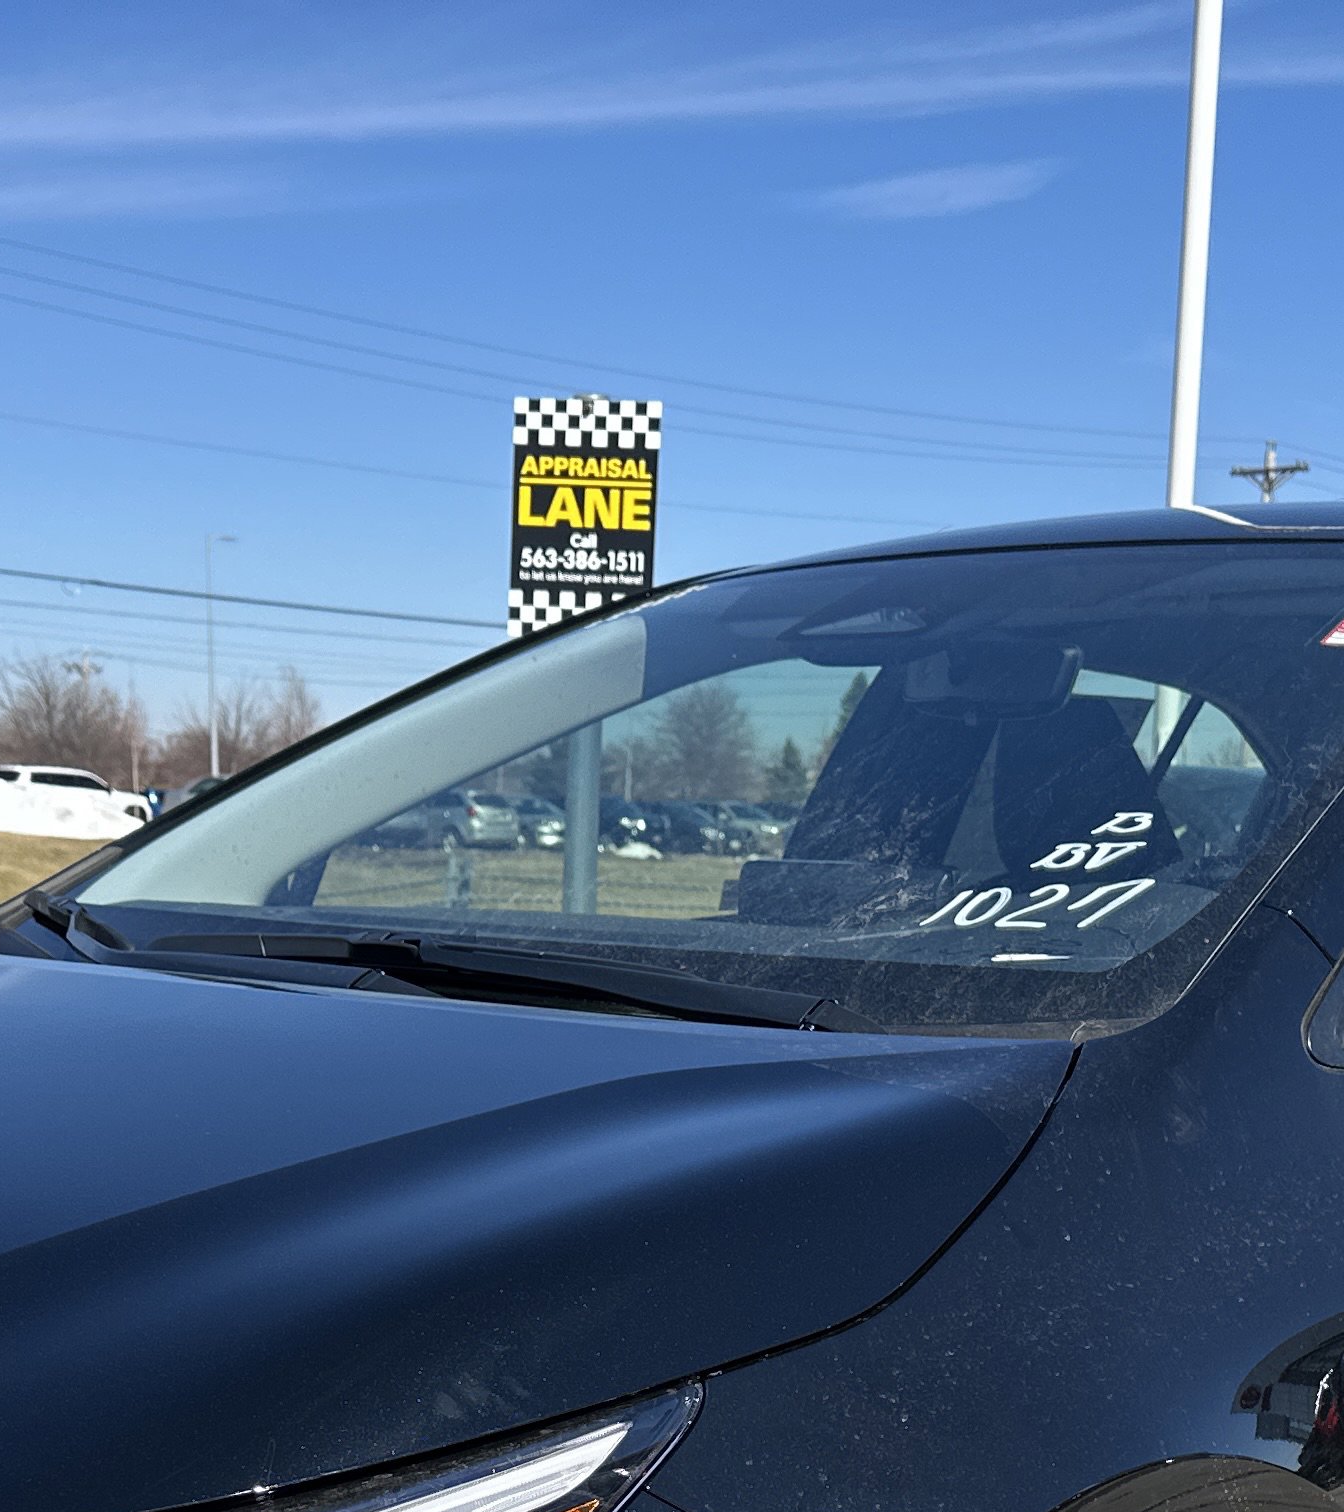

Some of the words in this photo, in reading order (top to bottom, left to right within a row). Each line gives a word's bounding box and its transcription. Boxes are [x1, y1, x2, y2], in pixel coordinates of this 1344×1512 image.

[520, 455, 653, 479] APPRAISAL
[518, 485, 653, 531] LANE
[569, 532, 598, 549] Call
[519, 546, 645, 572] 563-386-1511
[918, 877, 1156, 929] 1027
